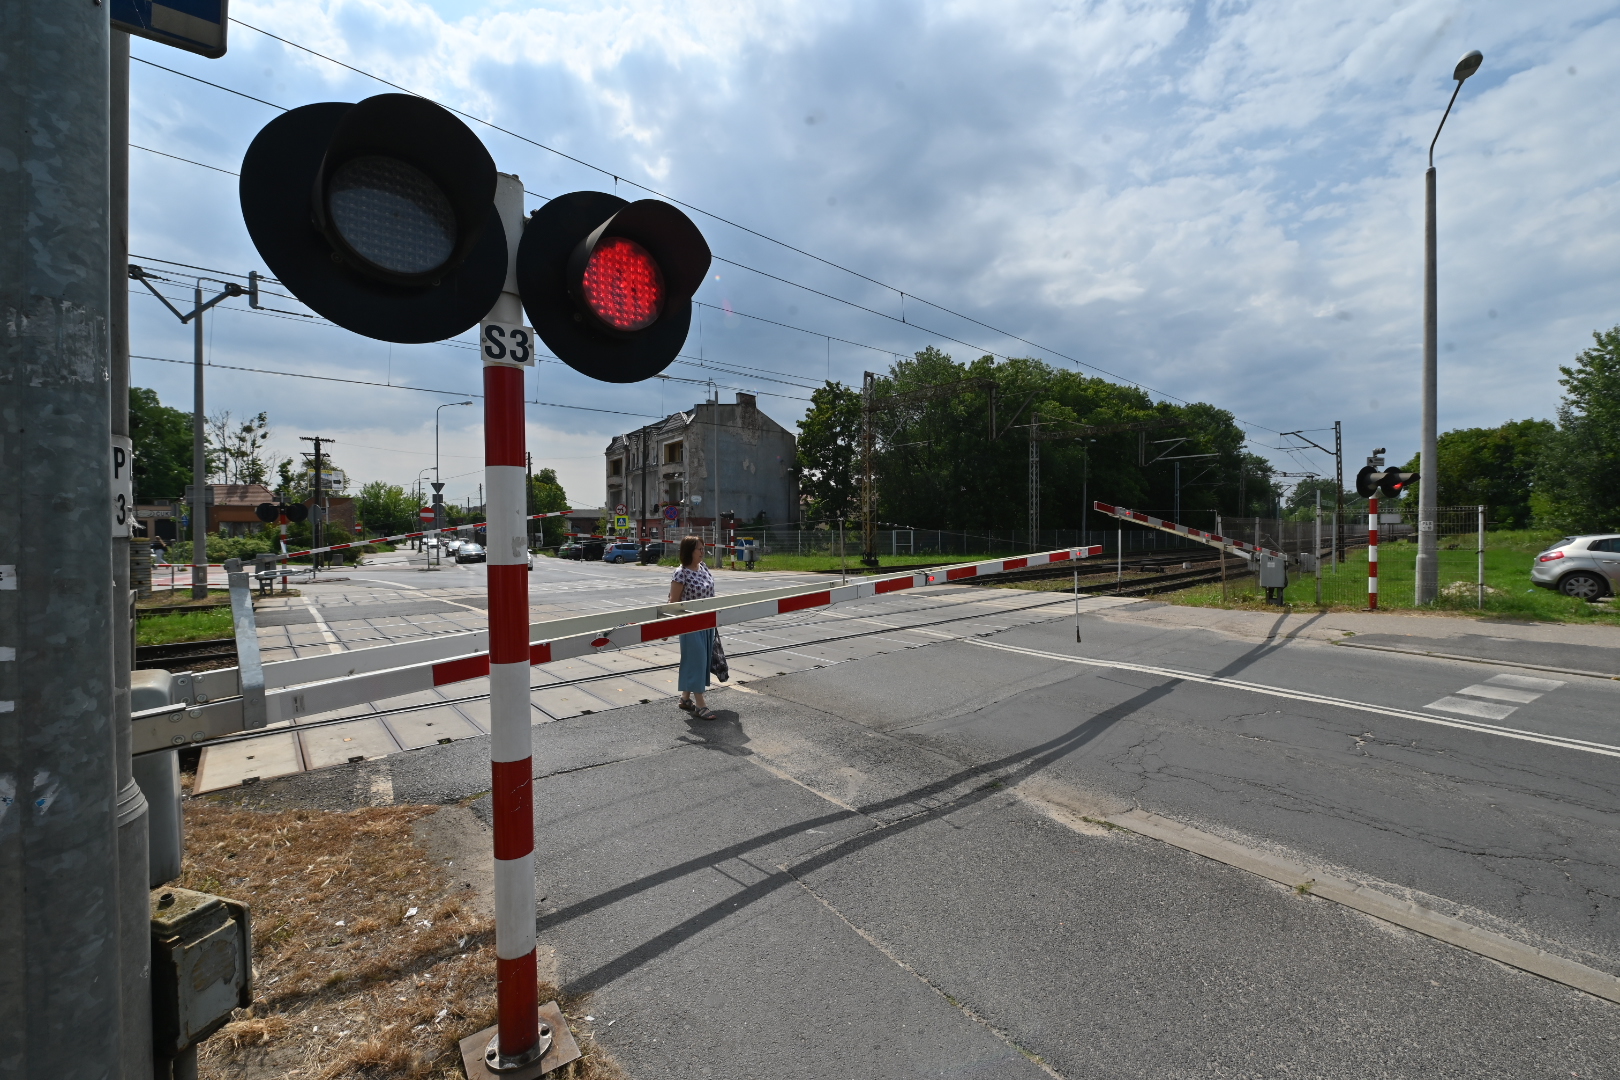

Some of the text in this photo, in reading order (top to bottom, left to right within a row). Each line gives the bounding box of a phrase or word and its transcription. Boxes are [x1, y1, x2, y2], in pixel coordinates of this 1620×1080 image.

[484, 324, 530, 363] S3
[113, 446, 126, 479] P
[116, 493, 126, 526] 3
